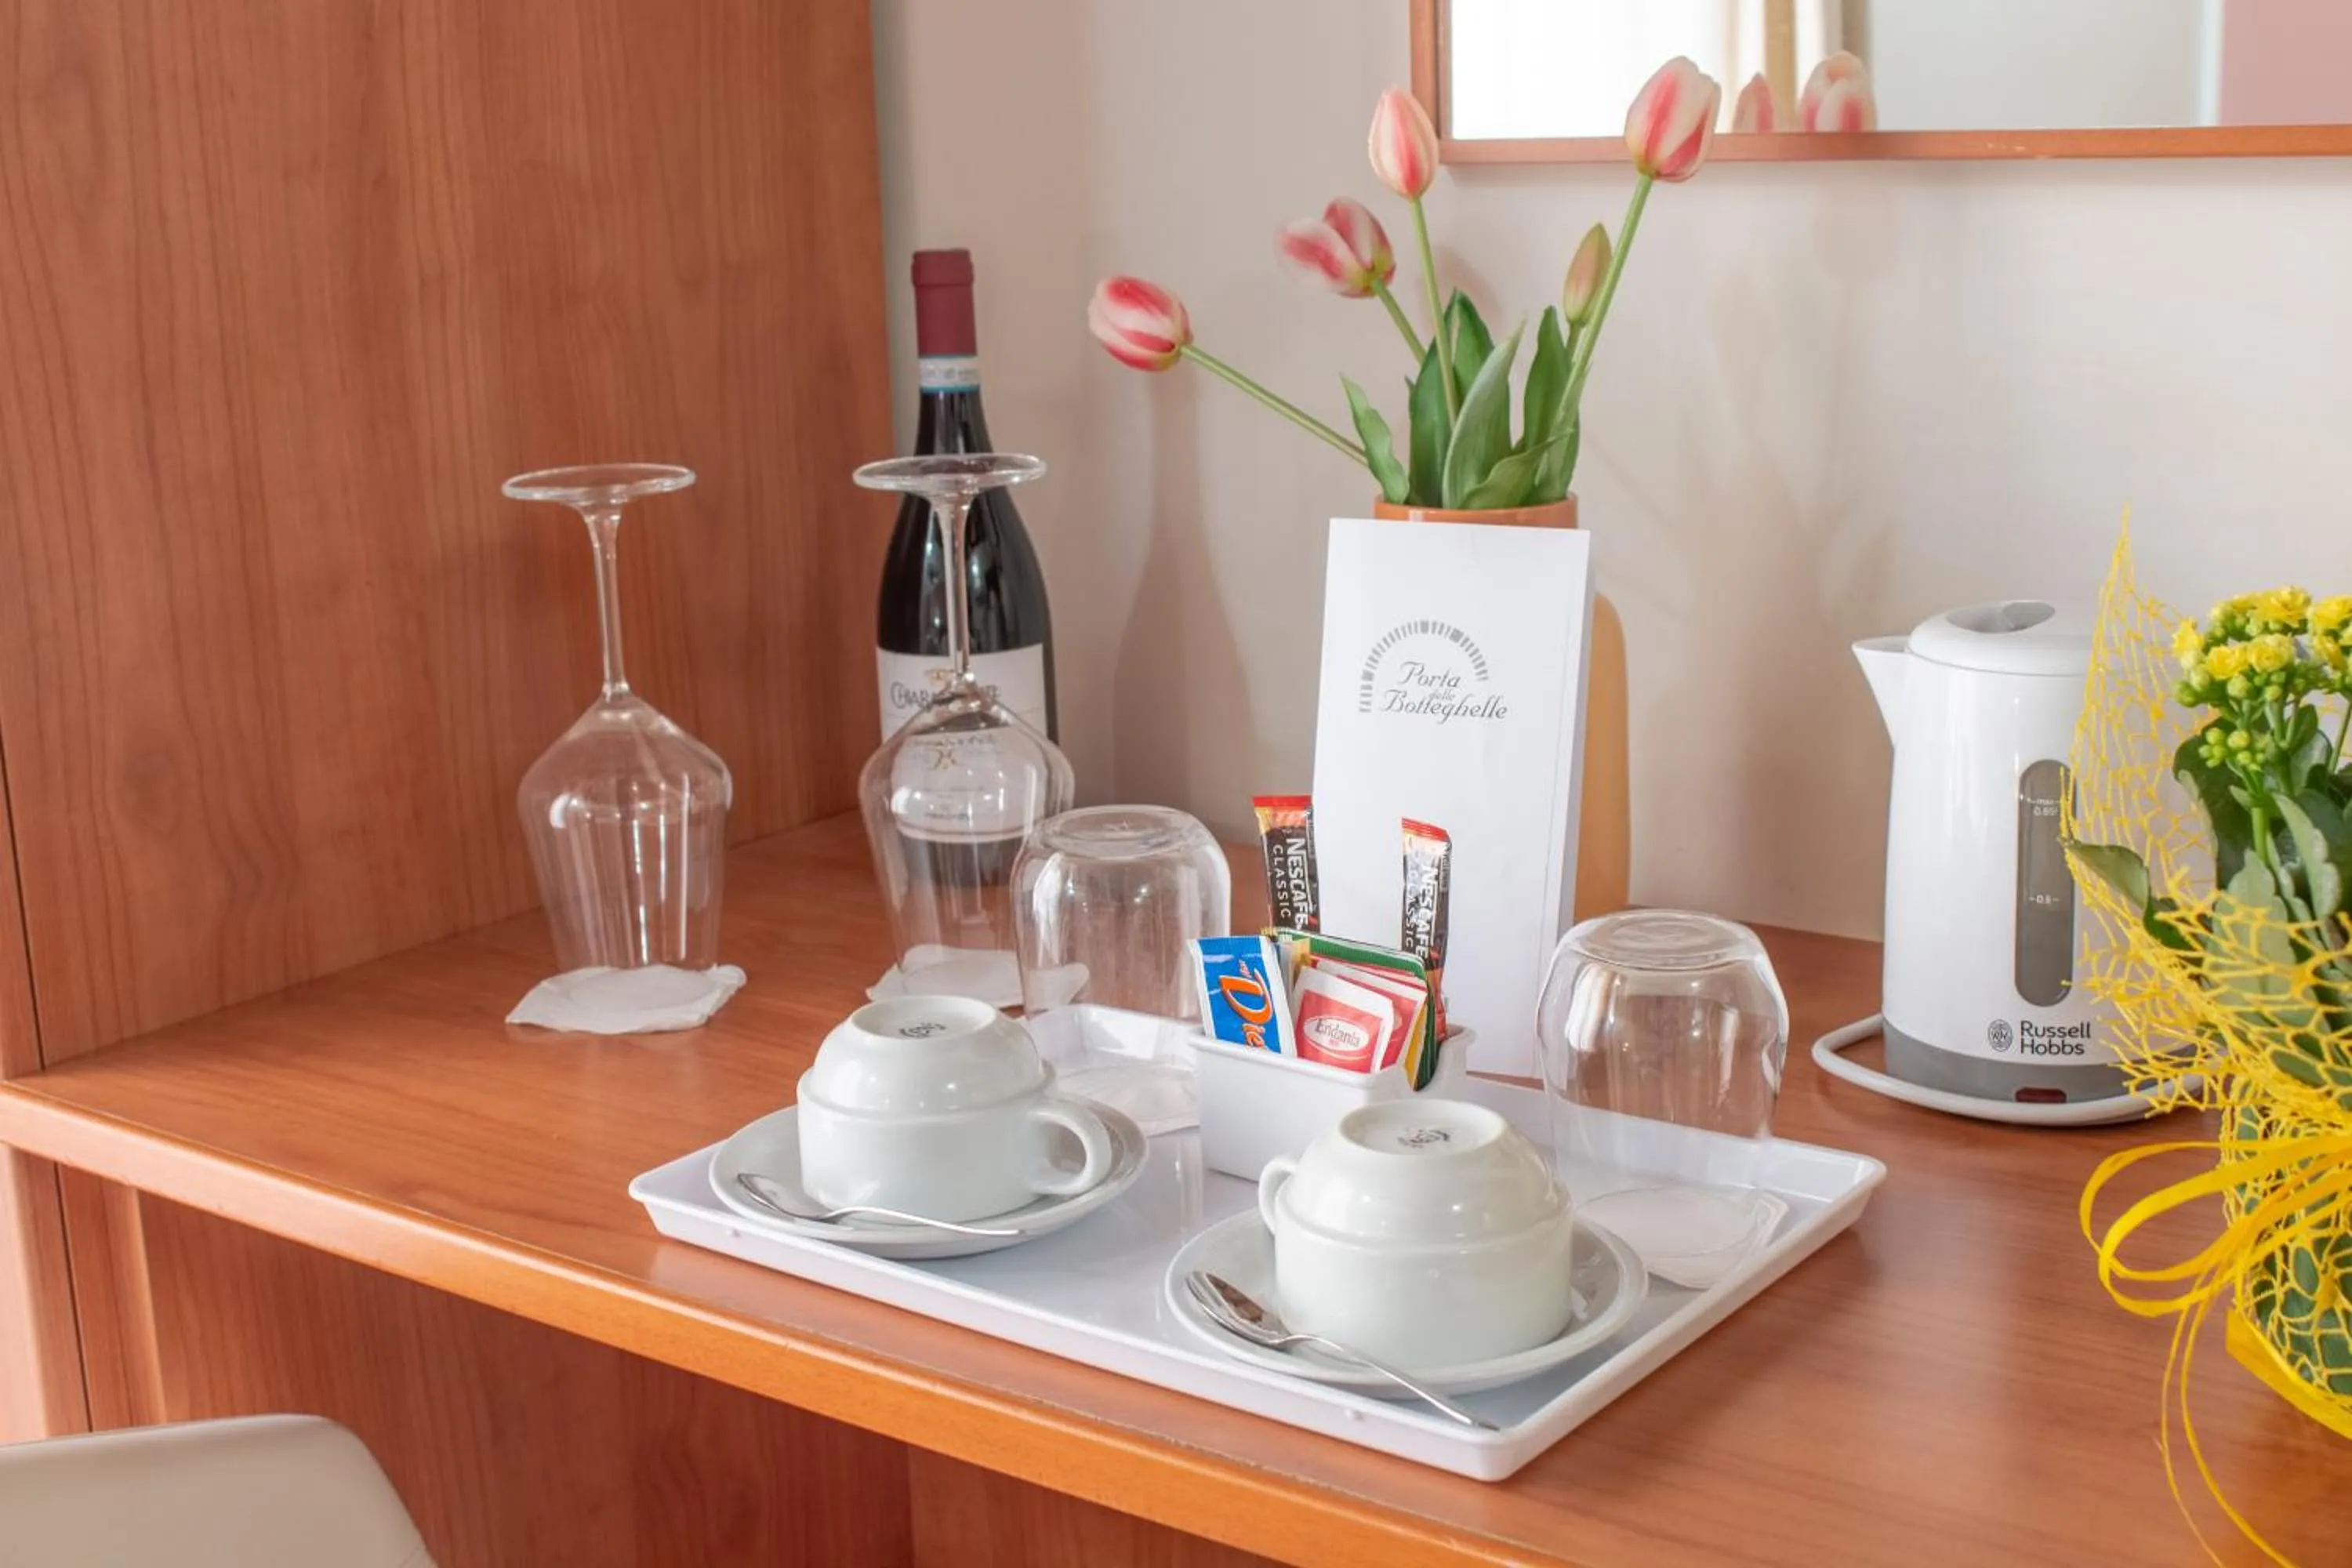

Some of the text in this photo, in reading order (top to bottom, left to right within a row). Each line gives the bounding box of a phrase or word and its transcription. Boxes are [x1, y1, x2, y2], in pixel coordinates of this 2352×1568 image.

[1397, 660, 1461, 688] Porta
[1380, 688, 1508, 724] Botteghelle
[1272, 845, 1291, 919] CLASSIC
[2020, 1020, 2091, 1039] Russell
[2020, 1037, 2085, 1055] Hobbs
